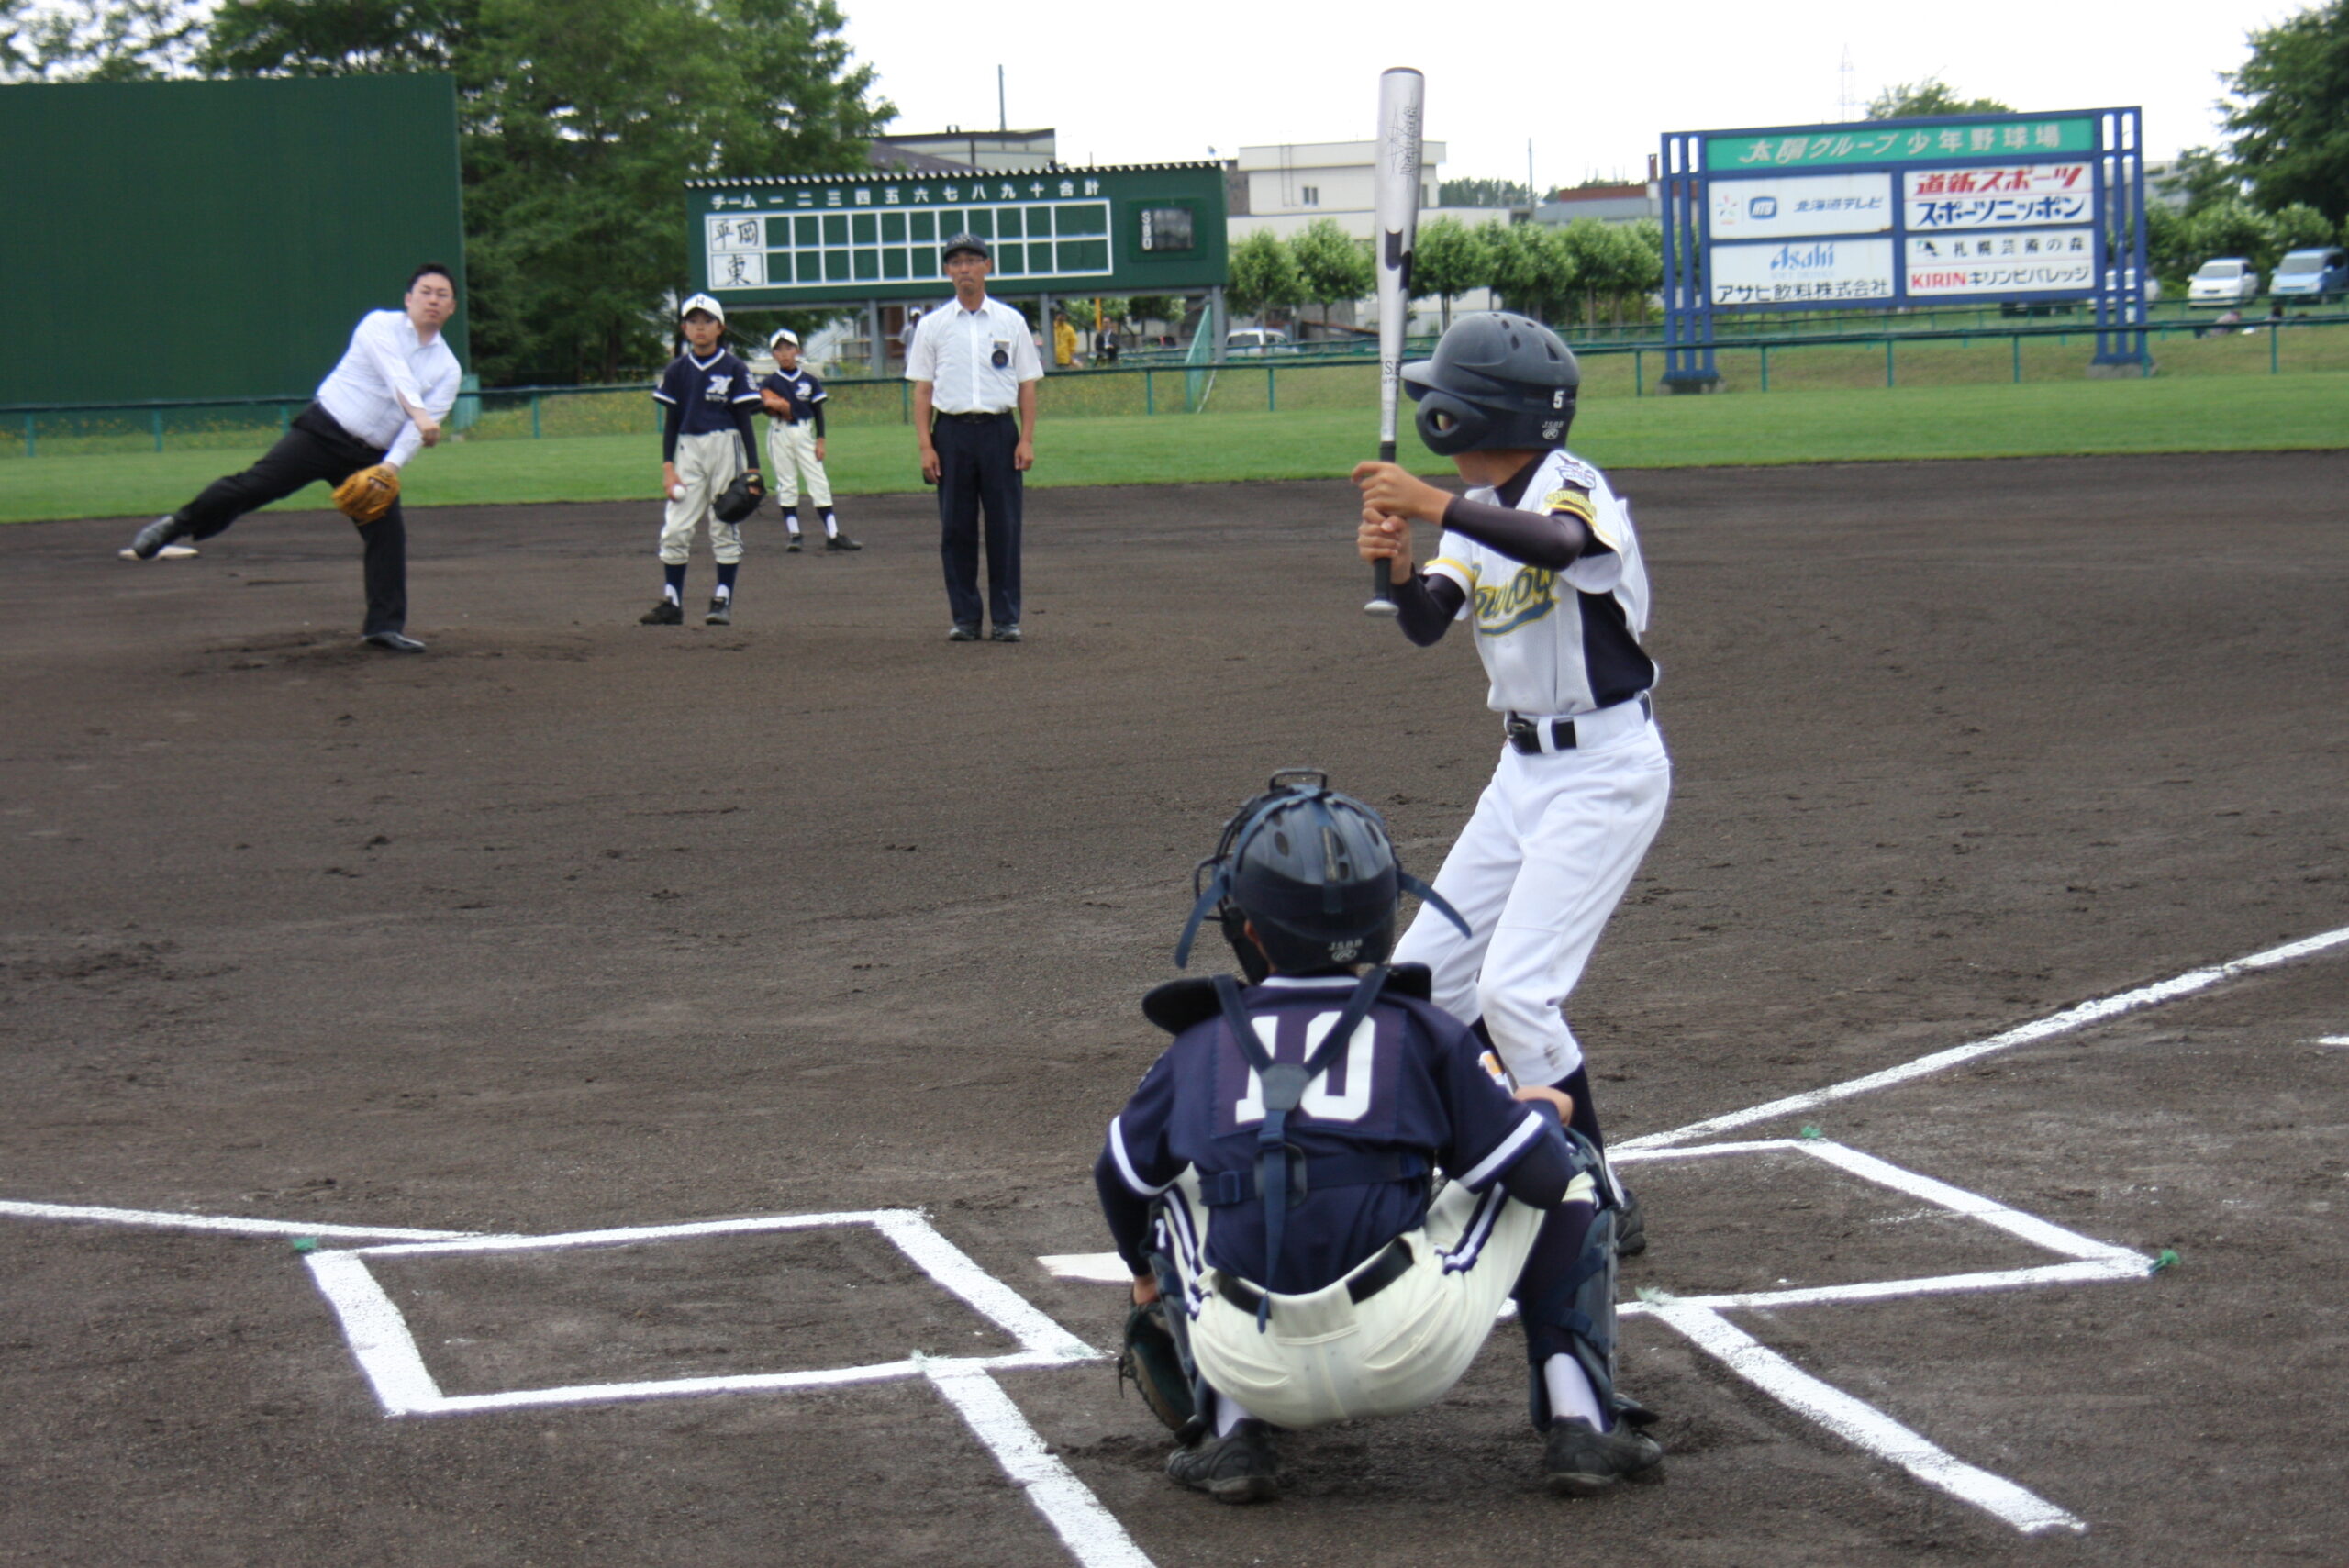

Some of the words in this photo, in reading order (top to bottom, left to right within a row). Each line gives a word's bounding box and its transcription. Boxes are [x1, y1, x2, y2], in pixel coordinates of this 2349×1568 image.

[1914, 166, 2083, 195] 道新スポーツ
[711, 192, 758, 210] チーム
[796, 191, 813, 207] 二
[827, 190, 842, 206] 三
[854, 188, 871, 206] 四
[884, 187, 900, 205] 五
[913, 186, 930, 203] 六
[943, 186, 959, 202] 七
[971, 184, 987, 201] 八
[1000, 183, 1017, 199] 九
[1030, 182, 1045, 198] 十
[1915, 195, 2085, 227] スポーツニッポン
[714, 220, 759, 250] 平岡
[1953, 236, 2085, 258] 札幌芸術の森
[726, 254, 751, 285] 東
[1769, 243, 1834, 271] Asahi
[1716, 279, 1889, 303] アサヒ飲料株式会社
[1910, 272, 1966, 289] KIRIN
[1553, 390, 1564, 409] 5
[1235, 1010, 1376, 1124] 10
